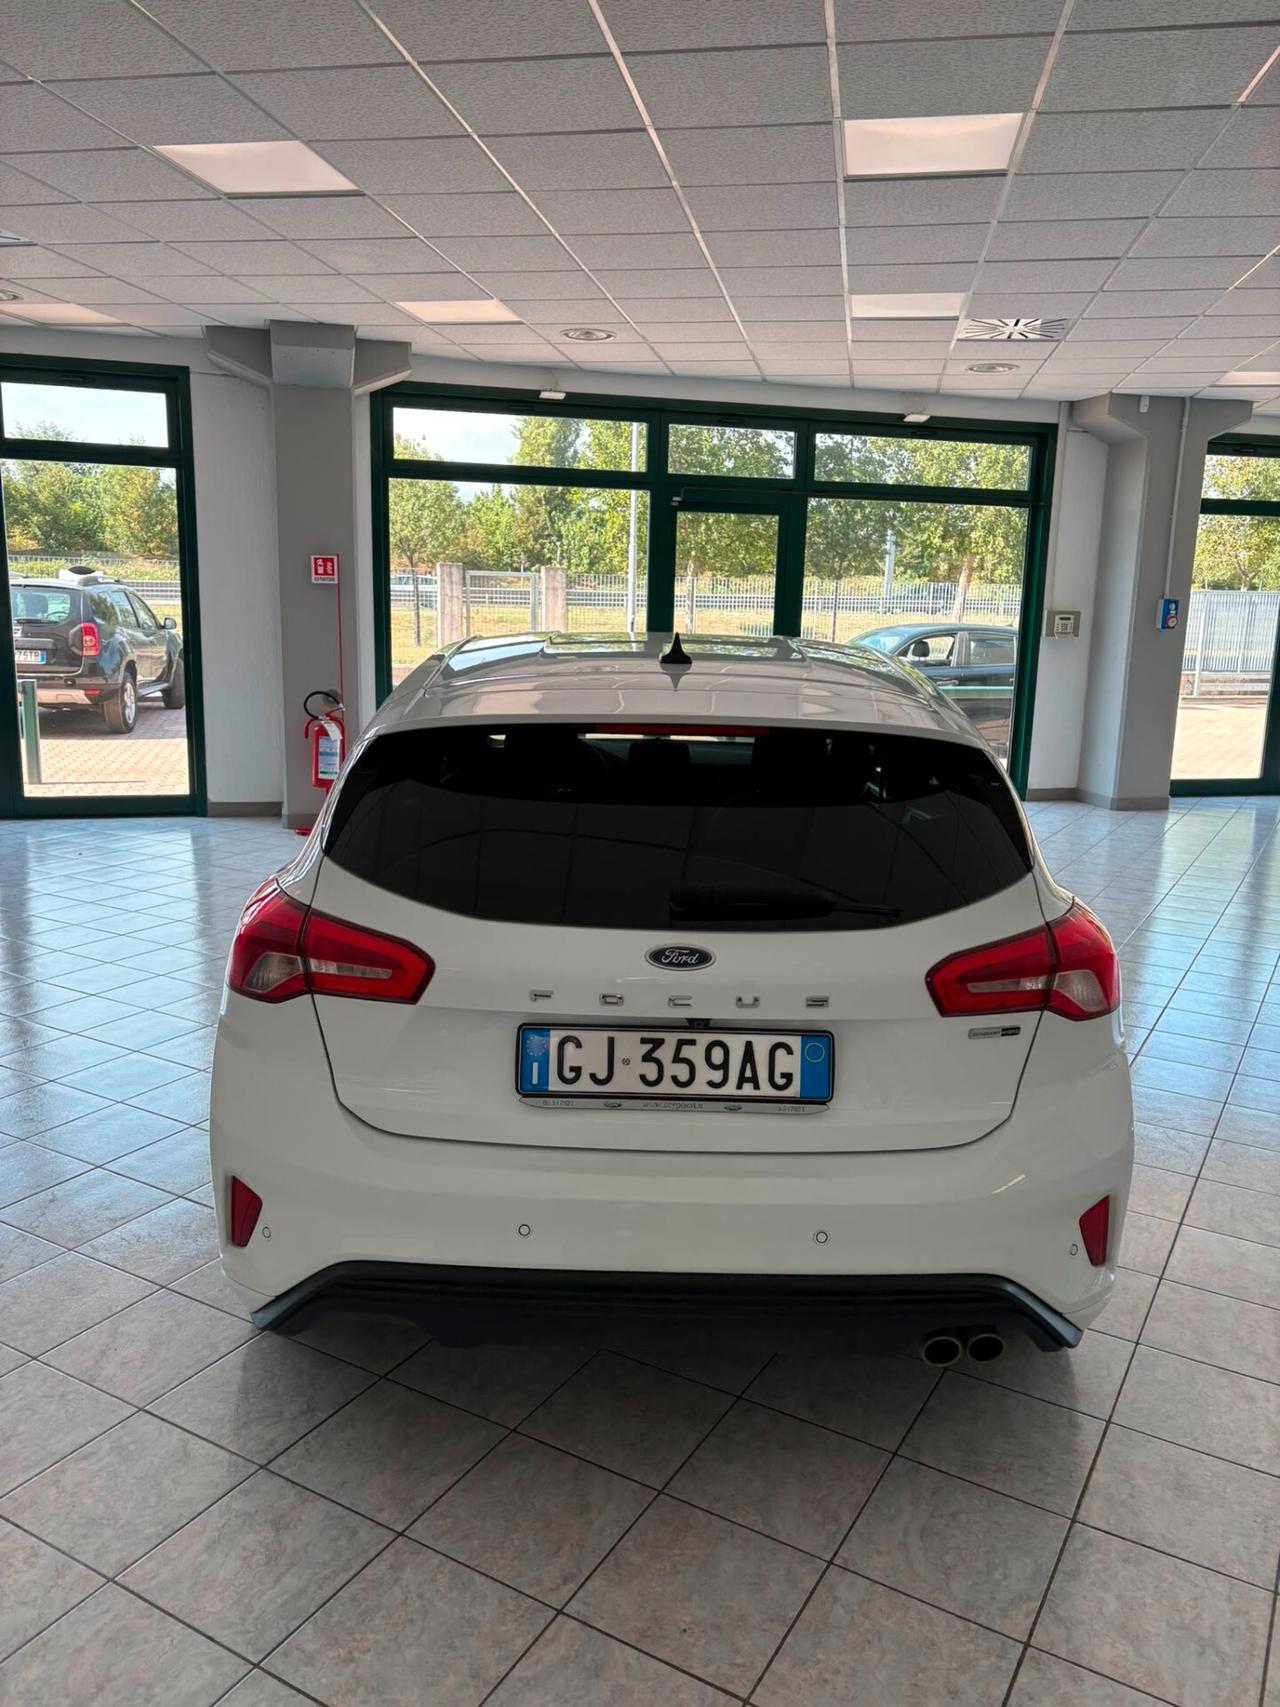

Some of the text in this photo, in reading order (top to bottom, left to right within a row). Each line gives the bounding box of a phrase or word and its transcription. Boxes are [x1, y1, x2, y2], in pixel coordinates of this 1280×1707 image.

[661, 948, 699, 964] Ford
[529, 989, 830, 1009] FOCUS
[557, 1035, 615, 1086] GJ
[639, 1037, 794, 1091] 359AG
